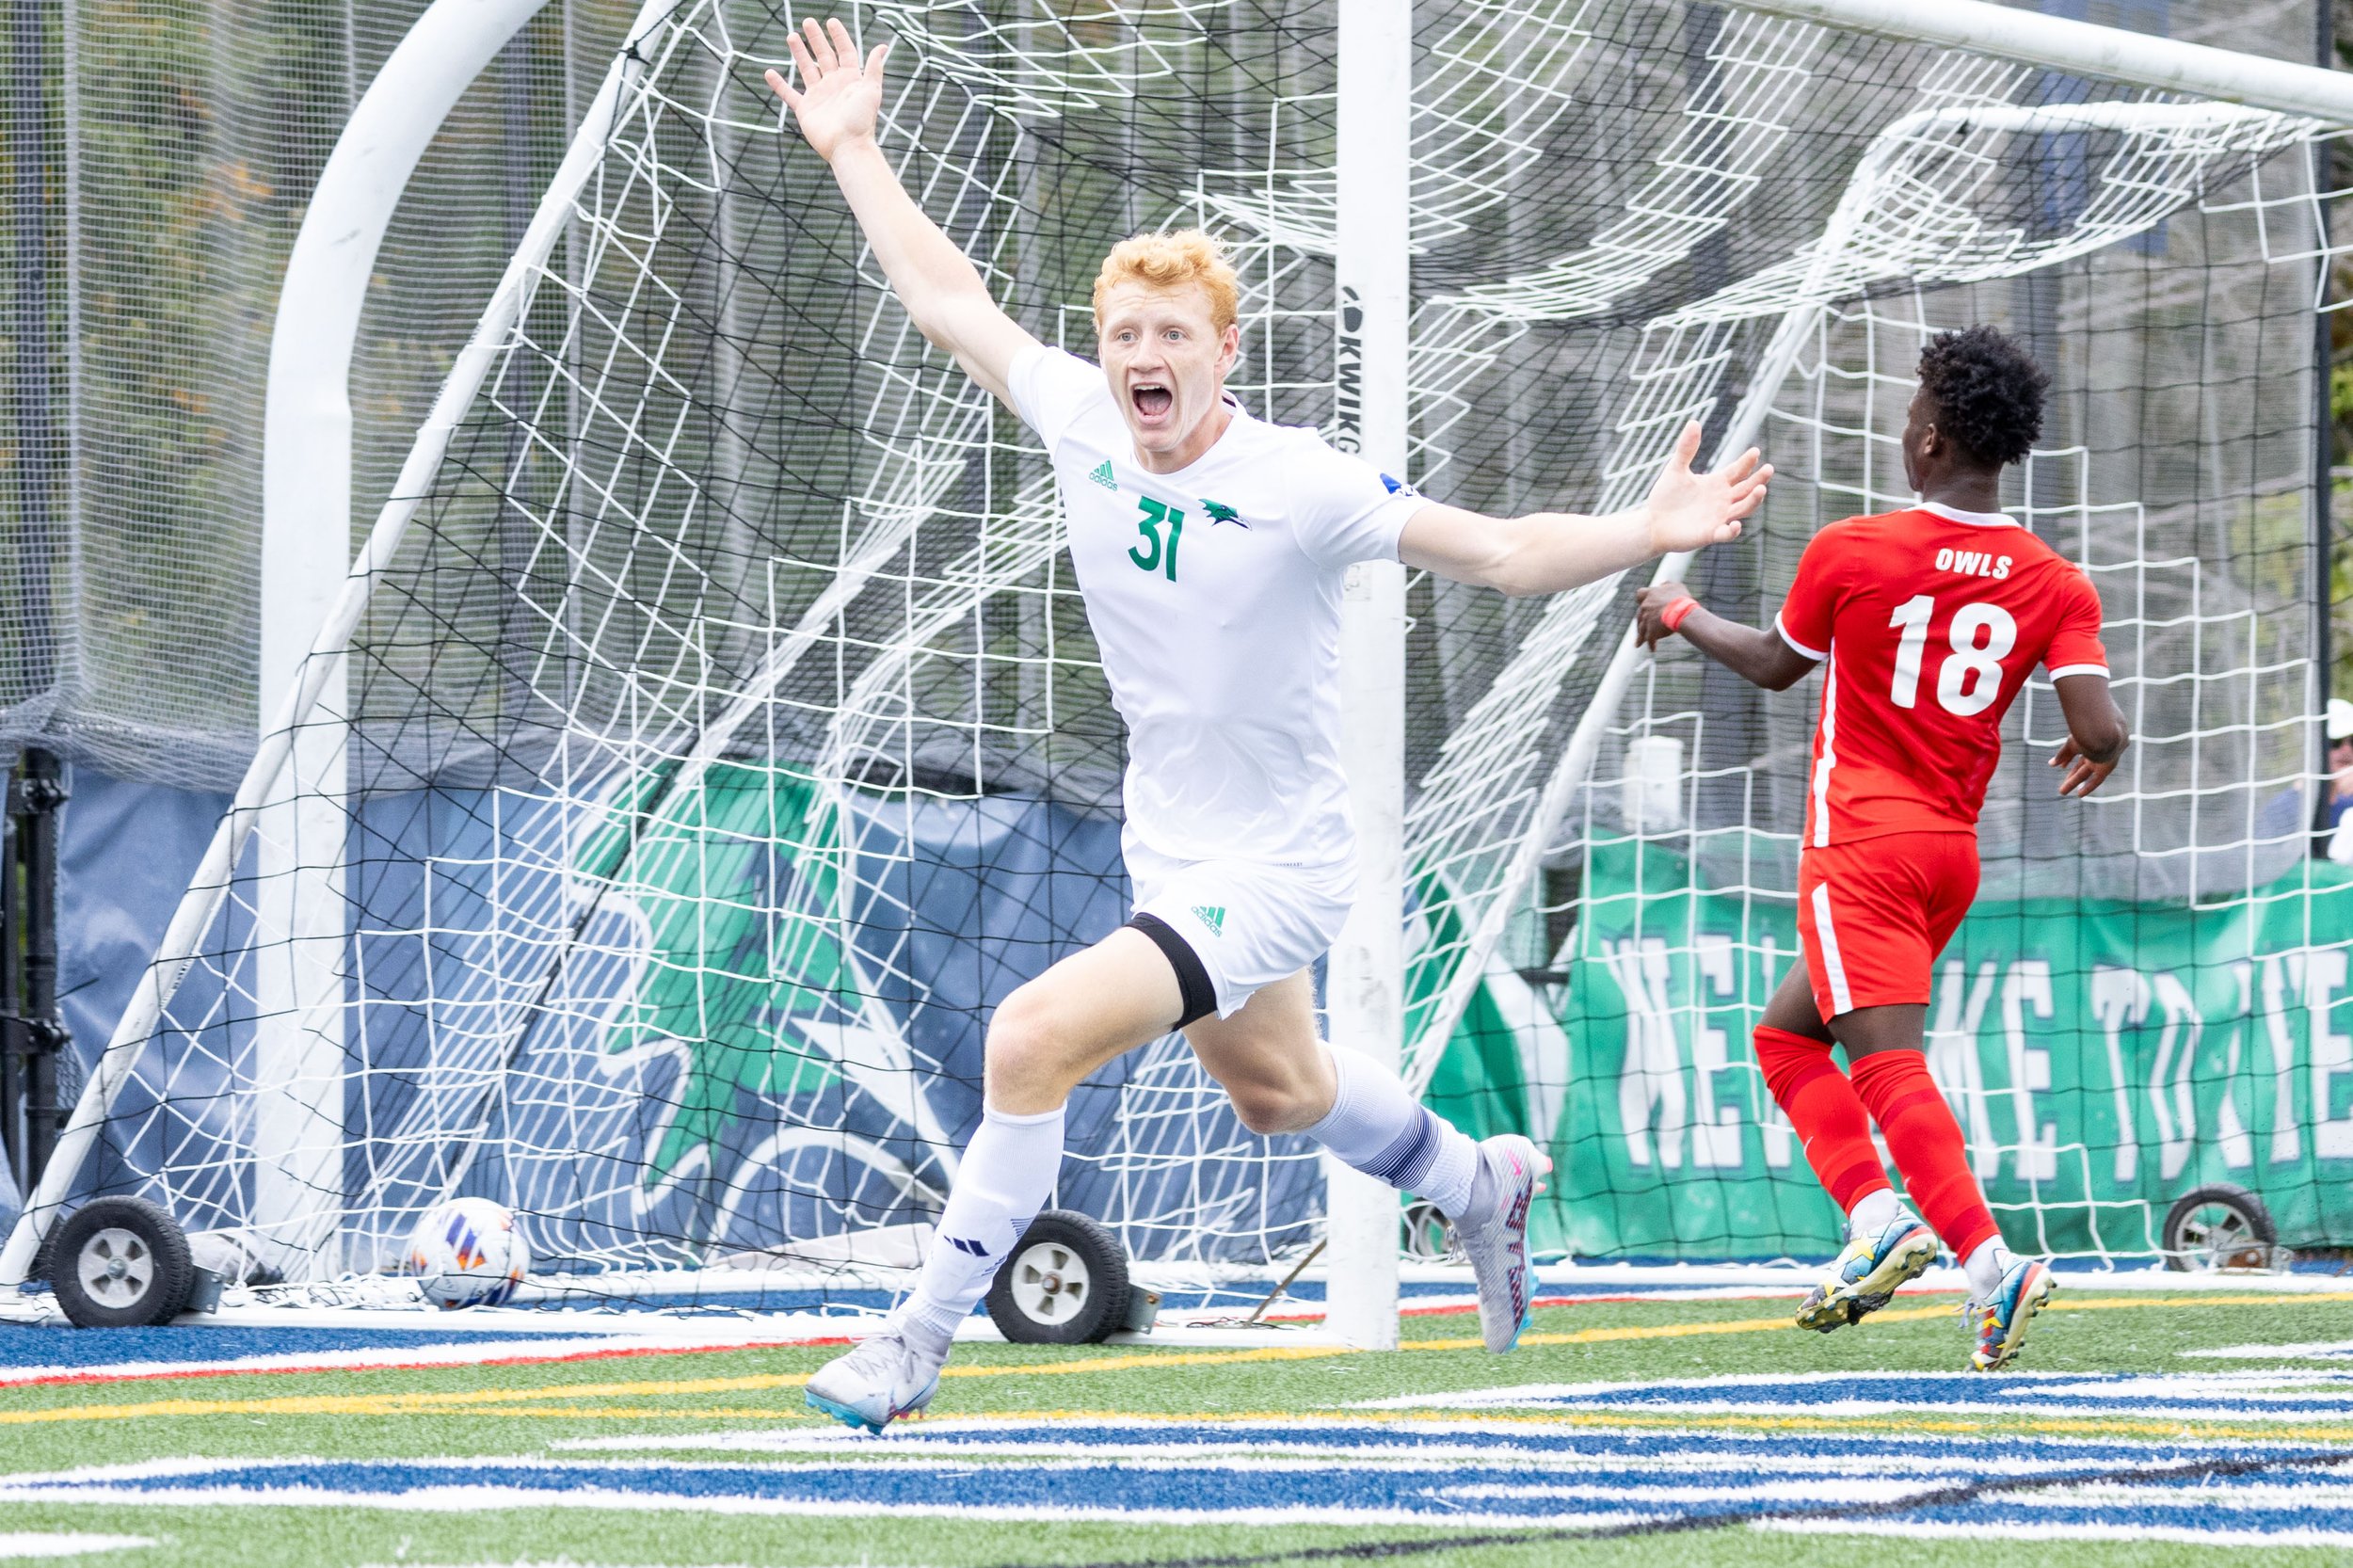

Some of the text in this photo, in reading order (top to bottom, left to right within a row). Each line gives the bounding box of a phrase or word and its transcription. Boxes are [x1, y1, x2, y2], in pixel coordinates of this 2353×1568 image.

[1088, 472, 1118, 491] adidas
[1128, 495, 1186, 583] 31
[1935, 548, 2013, 580] OWLS
[1888, 594, 2018, 717] 18
[1191, 905, 1223, 938] adidas
[2090, 963, 2203, 1181] TO
